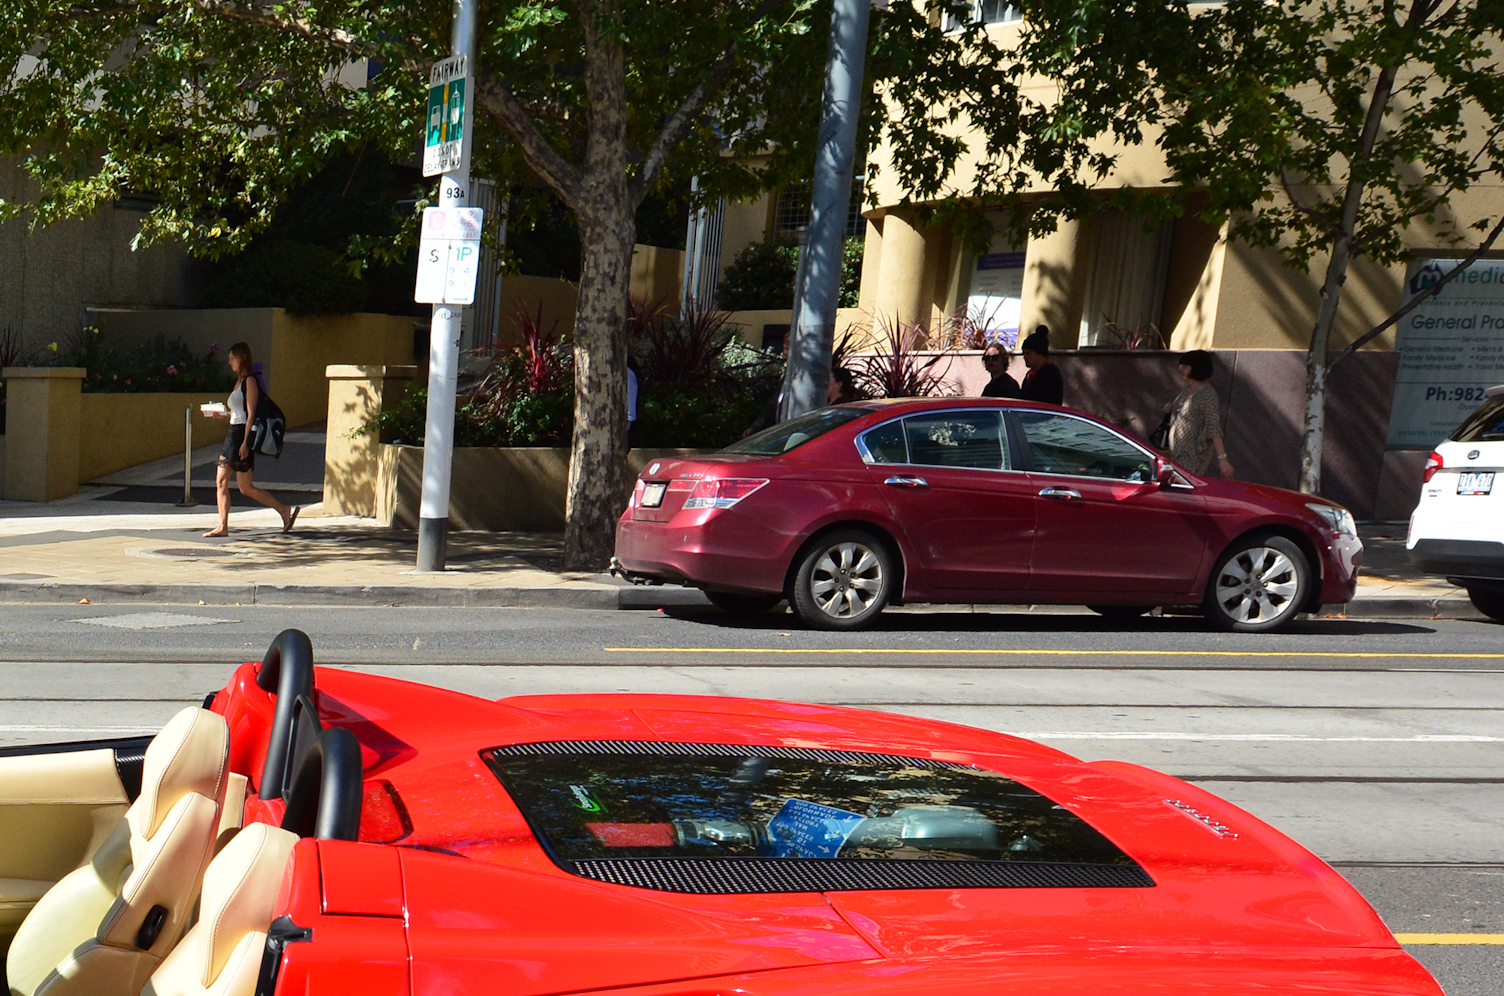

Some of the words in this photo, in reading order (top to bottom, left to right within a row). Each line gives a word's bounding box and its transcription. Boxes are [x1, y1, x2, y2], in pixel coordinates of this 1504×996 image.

[432, 57, 465, 82] FAIRWAY
[441, 144, 453, 156] NOT
[446, 187, 465, 199] 93A
[456, 246, 473, 262] 1P
[1411, 314, 1477, 330] General
